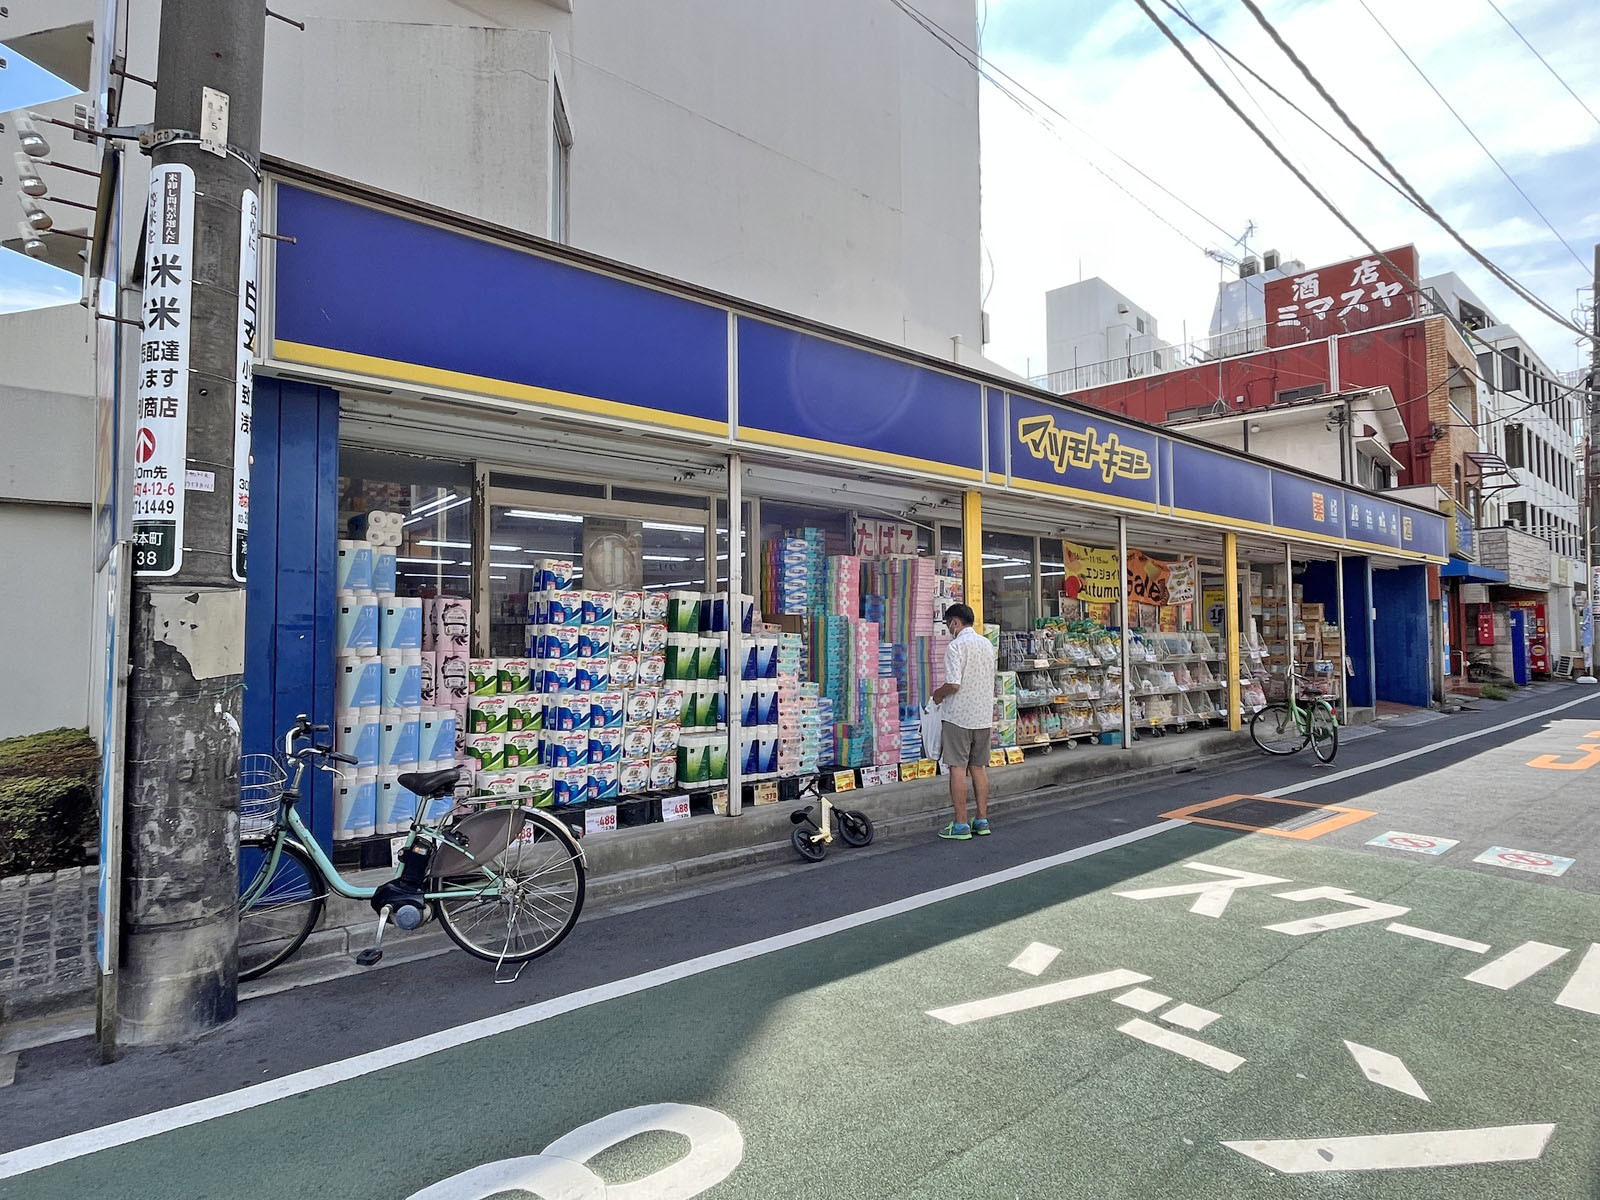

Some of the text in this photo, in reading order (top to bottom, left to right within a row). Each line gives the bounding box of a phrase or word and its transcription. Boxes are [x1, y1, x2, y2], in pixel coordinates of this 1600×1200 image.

[150, 253, 182, 288] 米
[1292, 259, 1381, 302] 酒店
[148, 296, 181, 331] 米
[1277, 282, 1403, 328] ミマスヤ
[1018, 415, 1152, 484] マツモトキヨシ
[857, 522, 914, 556] たばこ
[136, 550, 157, 566] 38
[600, 814, 616, 826] 488
[674, 804, 689, 814] 488
